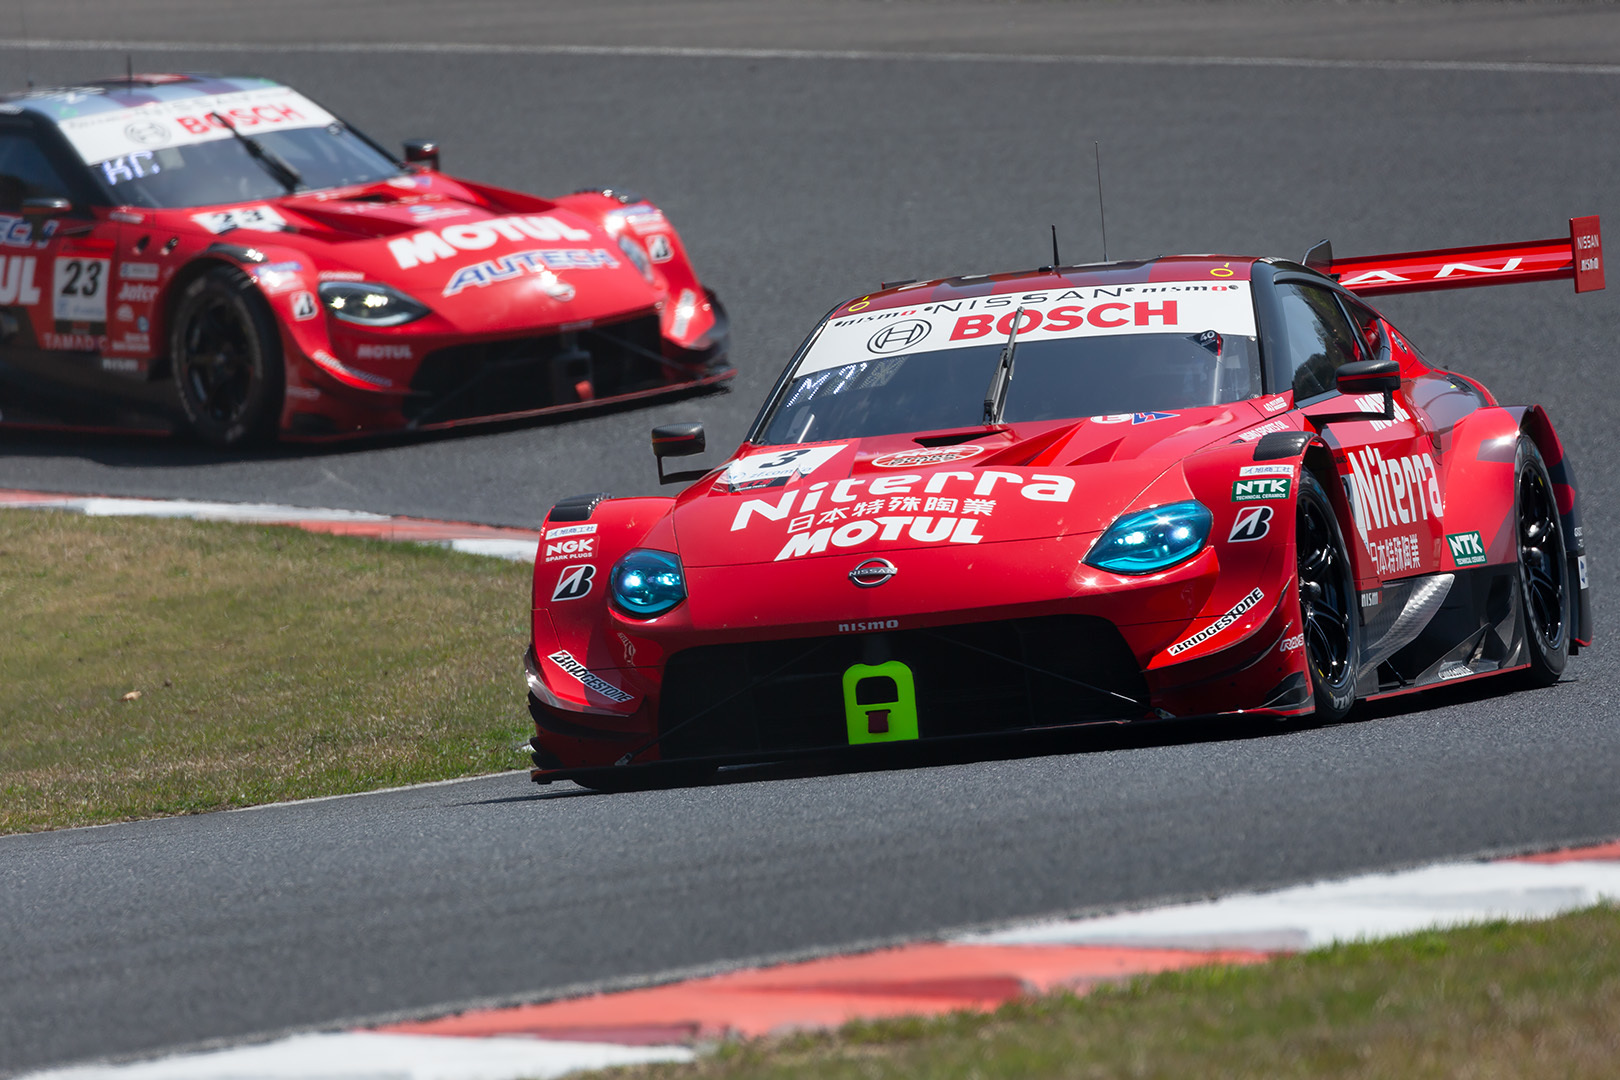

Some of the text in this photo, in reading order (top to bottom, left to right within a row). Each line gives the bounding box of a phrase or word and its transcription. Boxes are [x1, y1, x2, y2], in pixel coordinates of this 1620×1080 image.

[175, 103, 306, 135] BOSCH
[387, 217, 591, 270] MOTUL
[1577, 234, 1600, 250] NISSAN
[62, 260, 102, 298] 23
[442, 248, 621, 298] AUTECH
[933, 287, 1124, 315] NISSAN
[1142, 284, 1228, 294] nismo
[840, 306, 917, 328] nismo
[948, 300, 1178, 342] BOSCH
[357, 344, 413, 359] MOTUL
[758, 449, 812, 469] 3
[730, 469, 1077, 532] Niterra
[1236, 479, 1288, 495] NTK
[1347, 444, 1444, 532] Niterra
[787, 497, 997, 534] 日本特殊陶業
[546, 538, 594, 557] NGK
[773, 516, 985, 562] MOTUL
[1448, 532, 1484, 557] NTK
[545, 552, 593, 563] SPARK PLUGS
[849, 568, 898, 577] NISSAN
[838, 619, 900, 632] nismo
[1169, 588, 1264, 655] BRIDGESTONE
[548, 650, 635, 703] BRIDGESTONE
